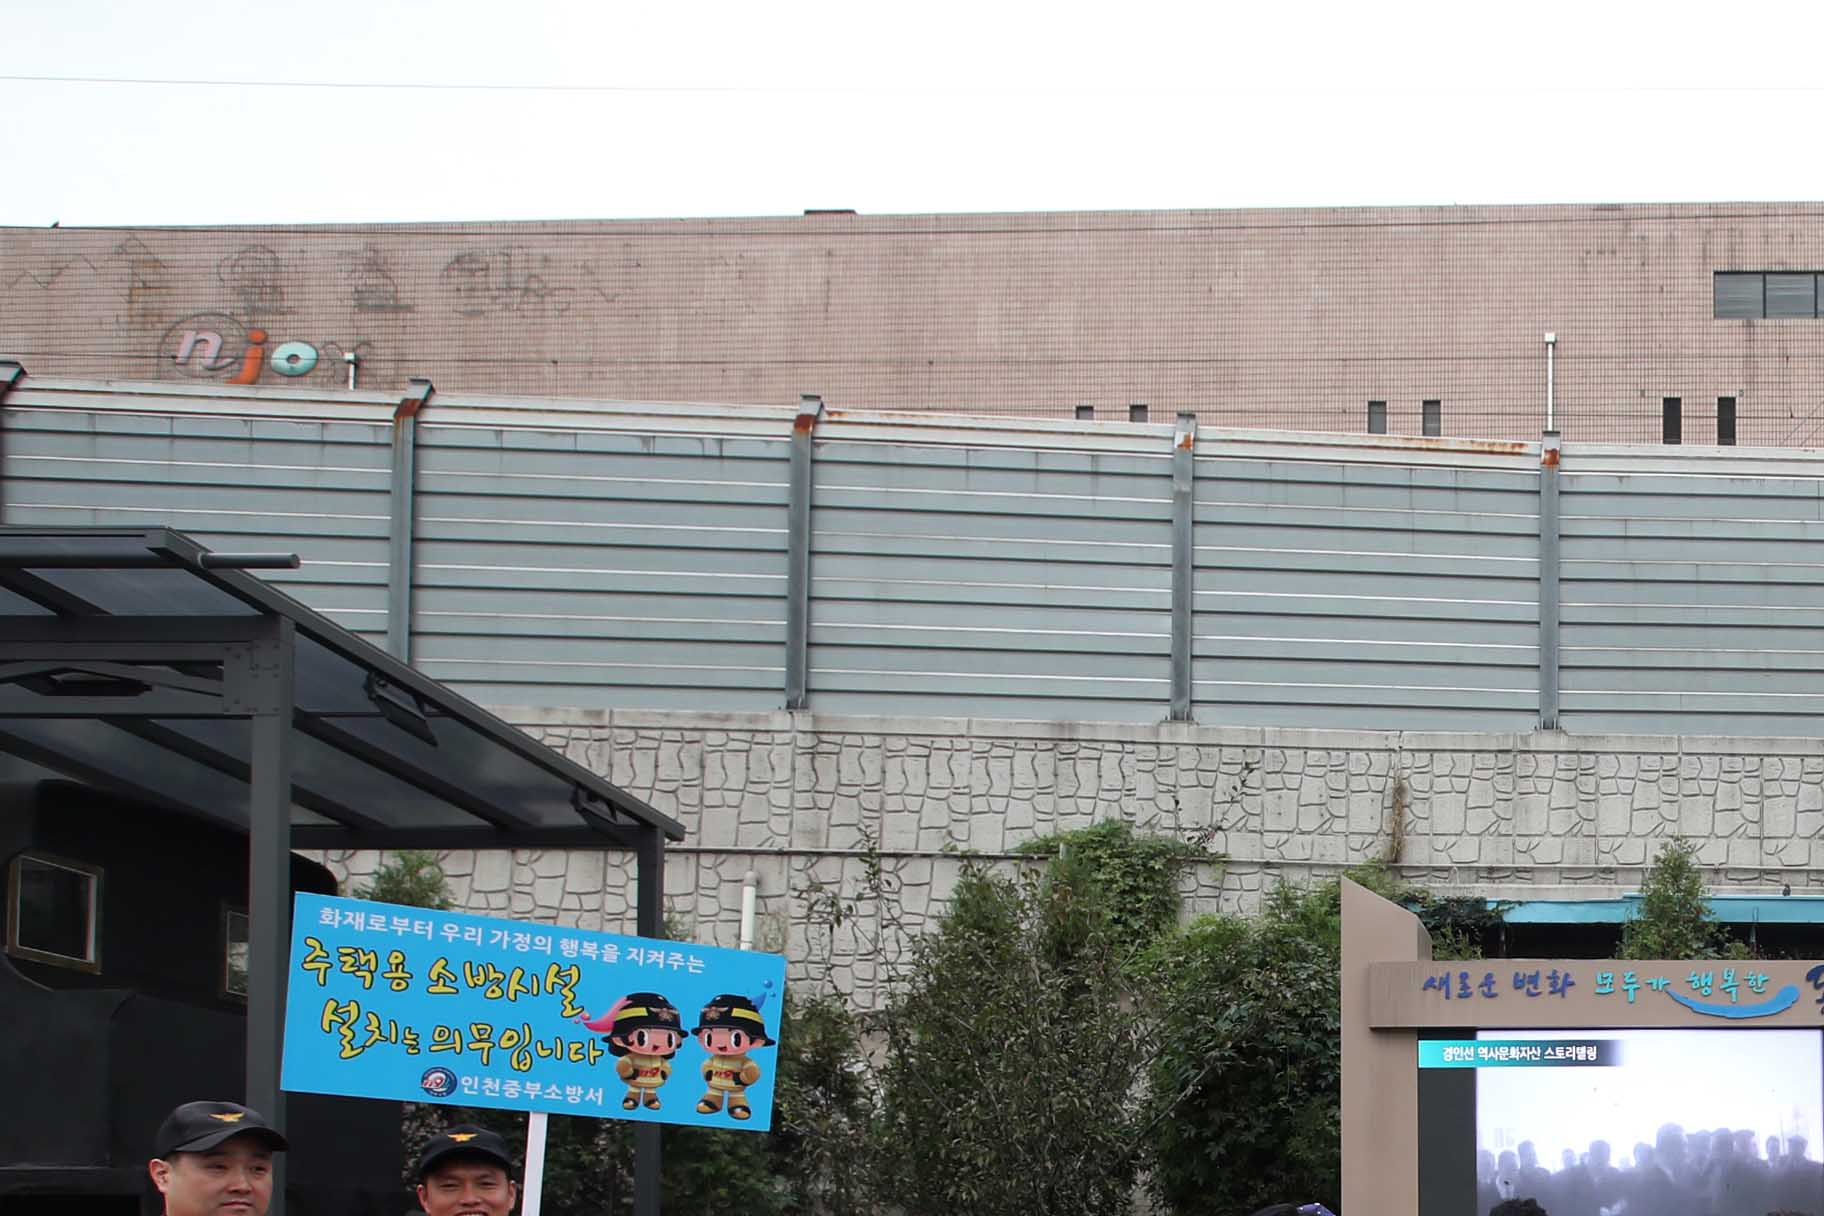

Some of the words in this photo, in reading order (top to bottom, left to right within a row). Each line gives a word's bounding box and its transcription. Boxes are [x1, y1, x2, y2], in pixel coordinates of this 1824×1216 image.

[319, 907, 435, 942] 화재로부터
[439, 923, 483, 947] 우리
[489, 930, 553, 954] 가정의
[559, 937, 622, 965] 행복을
[626, 945, 706, 974] 지켜주는
[301, 936, 413, 993] 주택용
[426, 958, 586, 1019] 소방시설
[1422, 970, 1498, 1000] 새로운
[1512, 969, 1575, 999] 변화
[1594, 970, 1674, 1001] 모두가
[1685, 967, 1770, 999] 행복한
[320, 998, 421, 1060] 설치는
[428, 1021, 605, 1073] 의무입니다
[461, 1074, 605, 1106] 인천중부소방서
